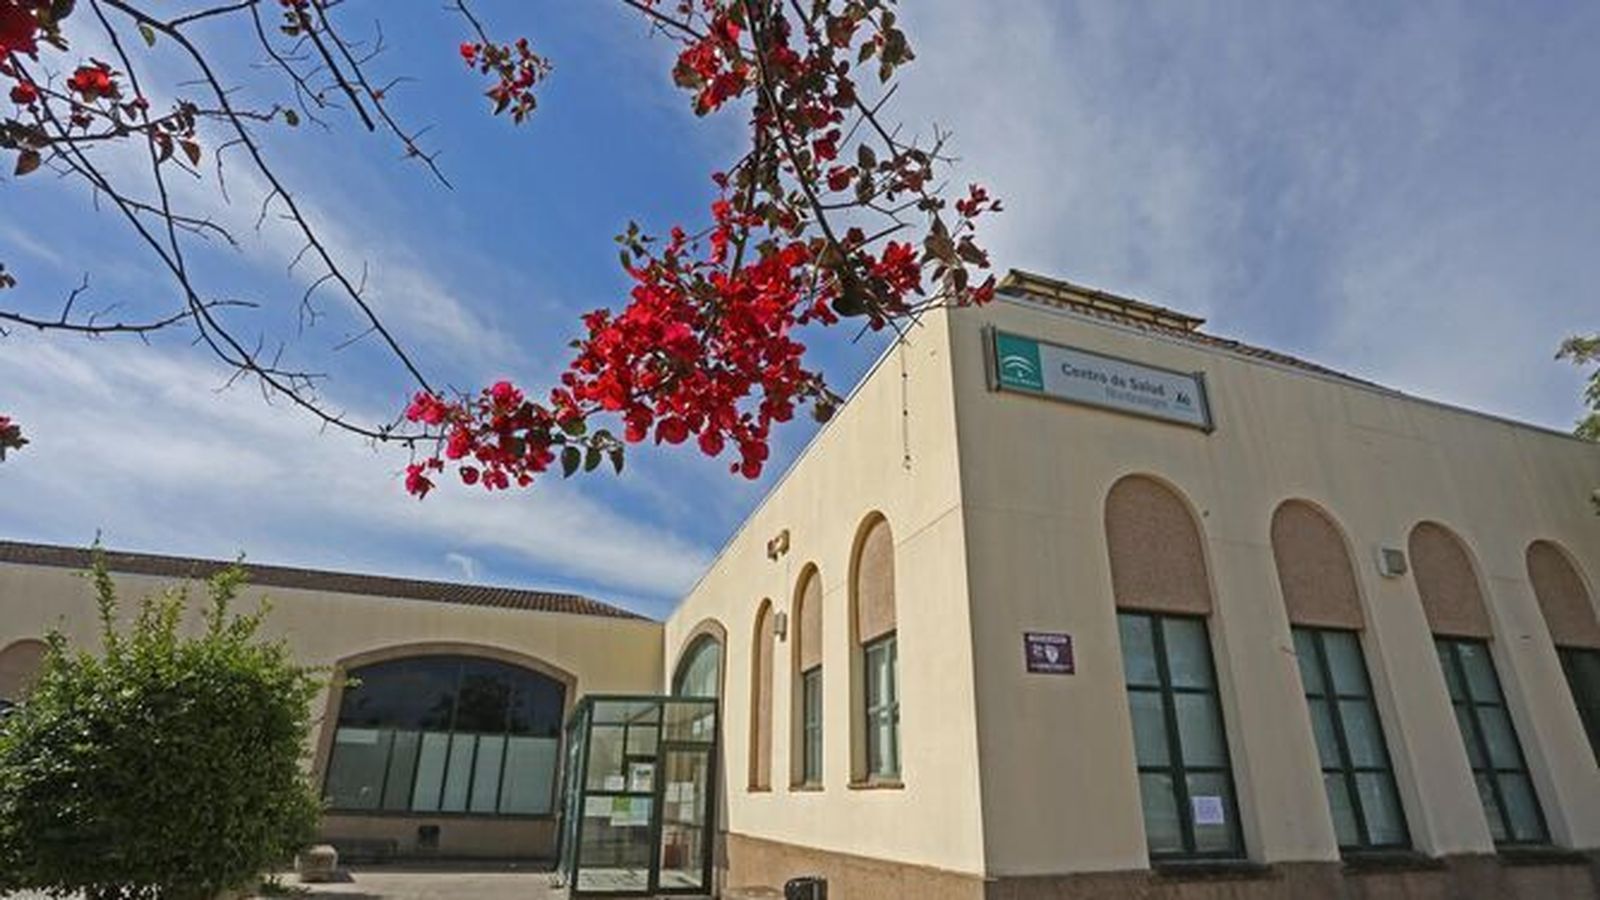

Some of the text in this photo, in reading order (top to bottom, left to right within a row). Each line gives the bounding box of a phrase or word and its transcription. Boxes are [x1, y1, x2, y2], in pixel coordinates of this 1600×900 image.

[1061, 363, 1108, 385] Centro
[1111, 374, 1127, 388] de
[1130, 377, 1165, 397] Salud
